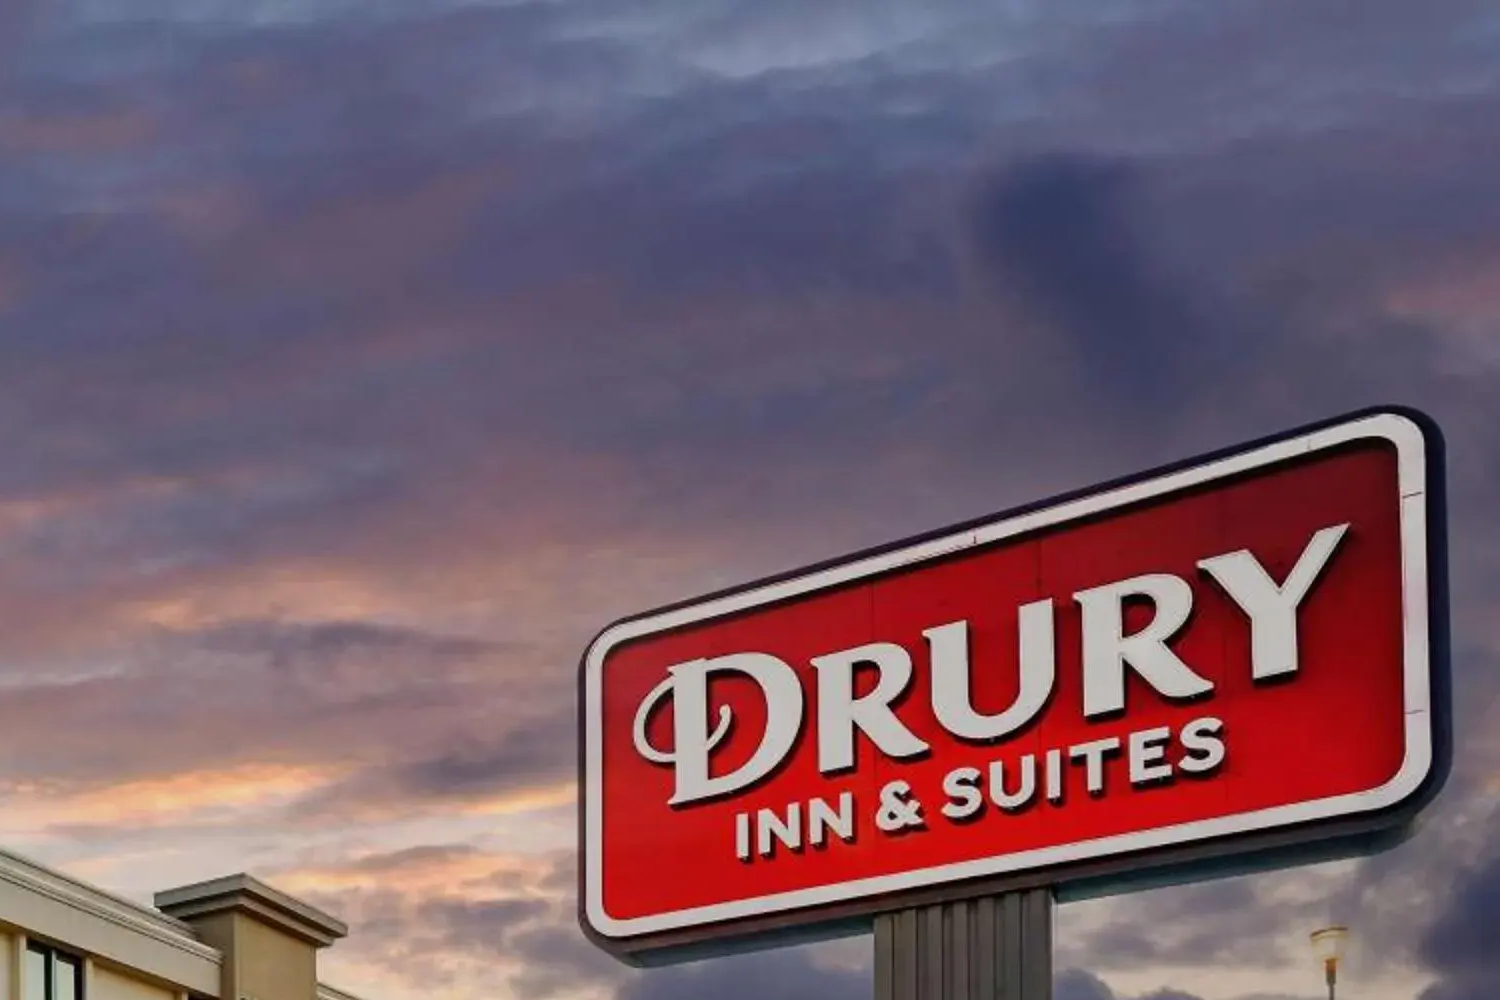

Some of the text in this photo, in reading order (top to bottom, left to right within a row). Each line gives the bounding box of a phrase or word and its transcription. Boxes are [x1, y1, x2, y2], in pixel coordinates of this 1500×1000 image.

[633, 522, 1350, 806] DRURY
[736, 717, 1227, 860] INN & SUITES
